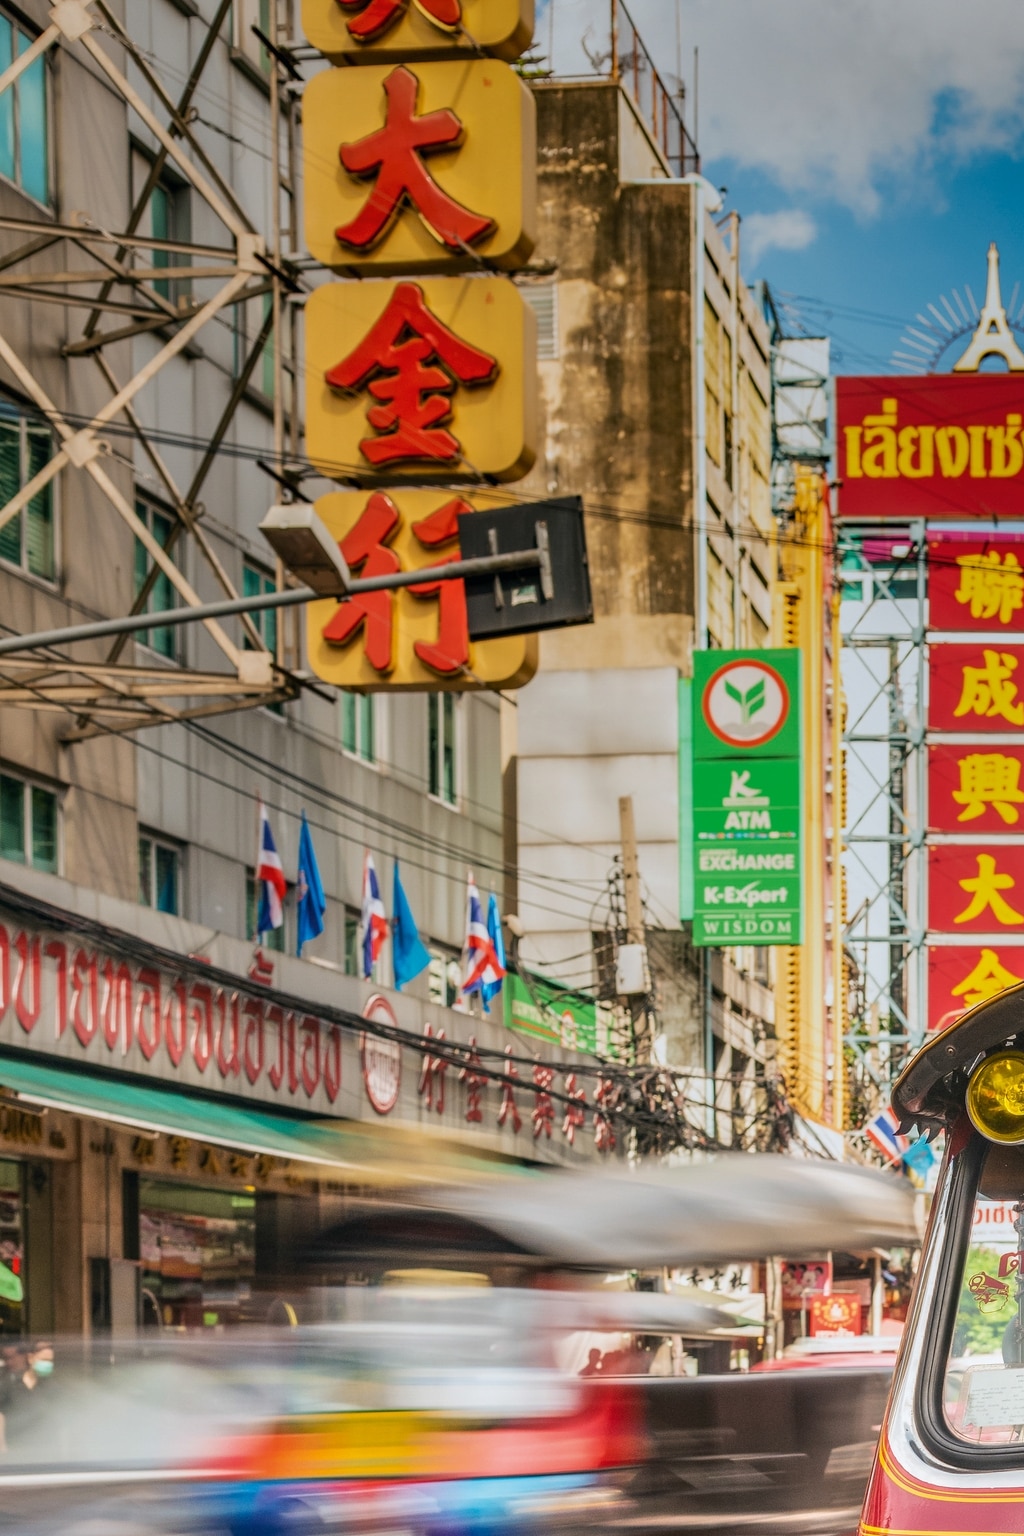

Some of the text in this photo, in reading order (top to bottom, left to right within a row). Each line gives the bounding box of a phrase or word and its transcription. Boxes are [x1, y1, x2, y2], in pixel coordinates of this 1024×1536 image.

[323, 0, 499, 675] 大金行
[724, 811, 771, 830] ATM
[699, 854, 795, 871] EXCHANGE
[703, 881, 788, 908] K-Expert
[703, 920, 792, 934] WISDOM
